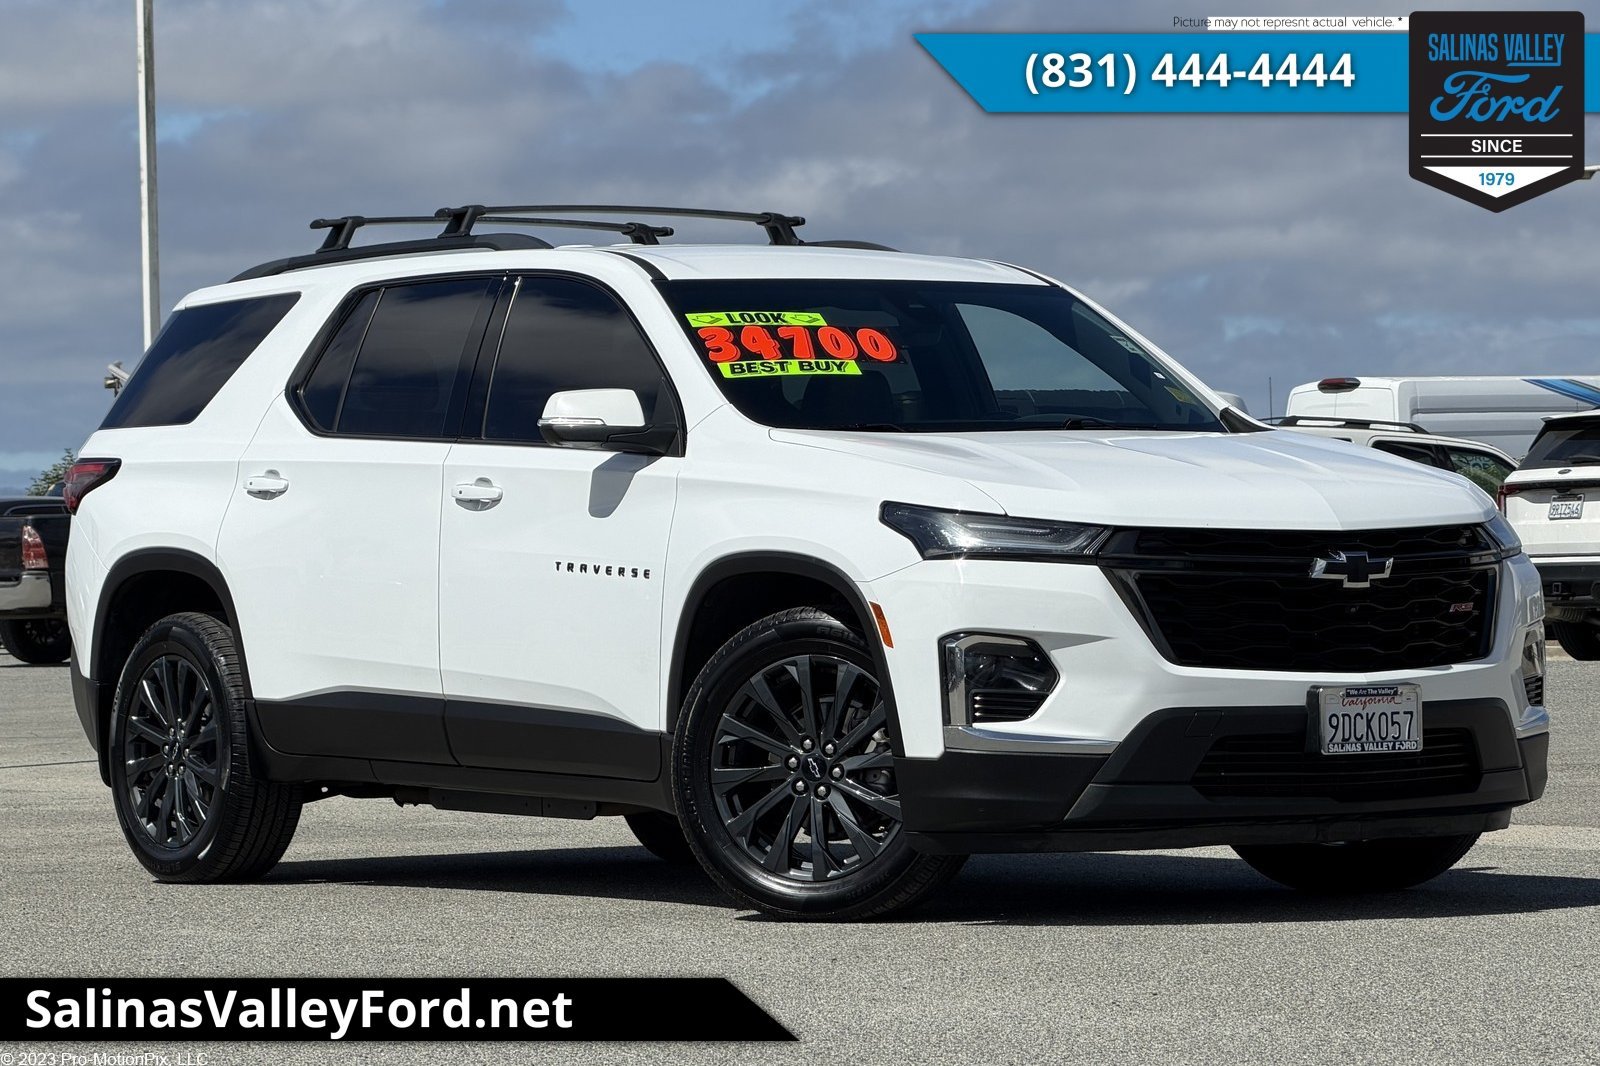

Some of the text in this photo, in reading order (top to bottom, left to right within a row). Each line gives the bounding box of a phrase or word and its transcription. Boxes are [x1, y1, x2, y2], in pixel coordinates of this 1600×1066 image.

[726, 312, 787, 325] LOOK
[697, 325, 897, 362] 34700
[729, 360, 846, 376] BEST BUY
[555, 561, 651, 579] TRAVERSE
[1328, 711, 1414, 743] 9DCK057
[1328, 741, 1417, 753] SALINAS VALLEY FORD
